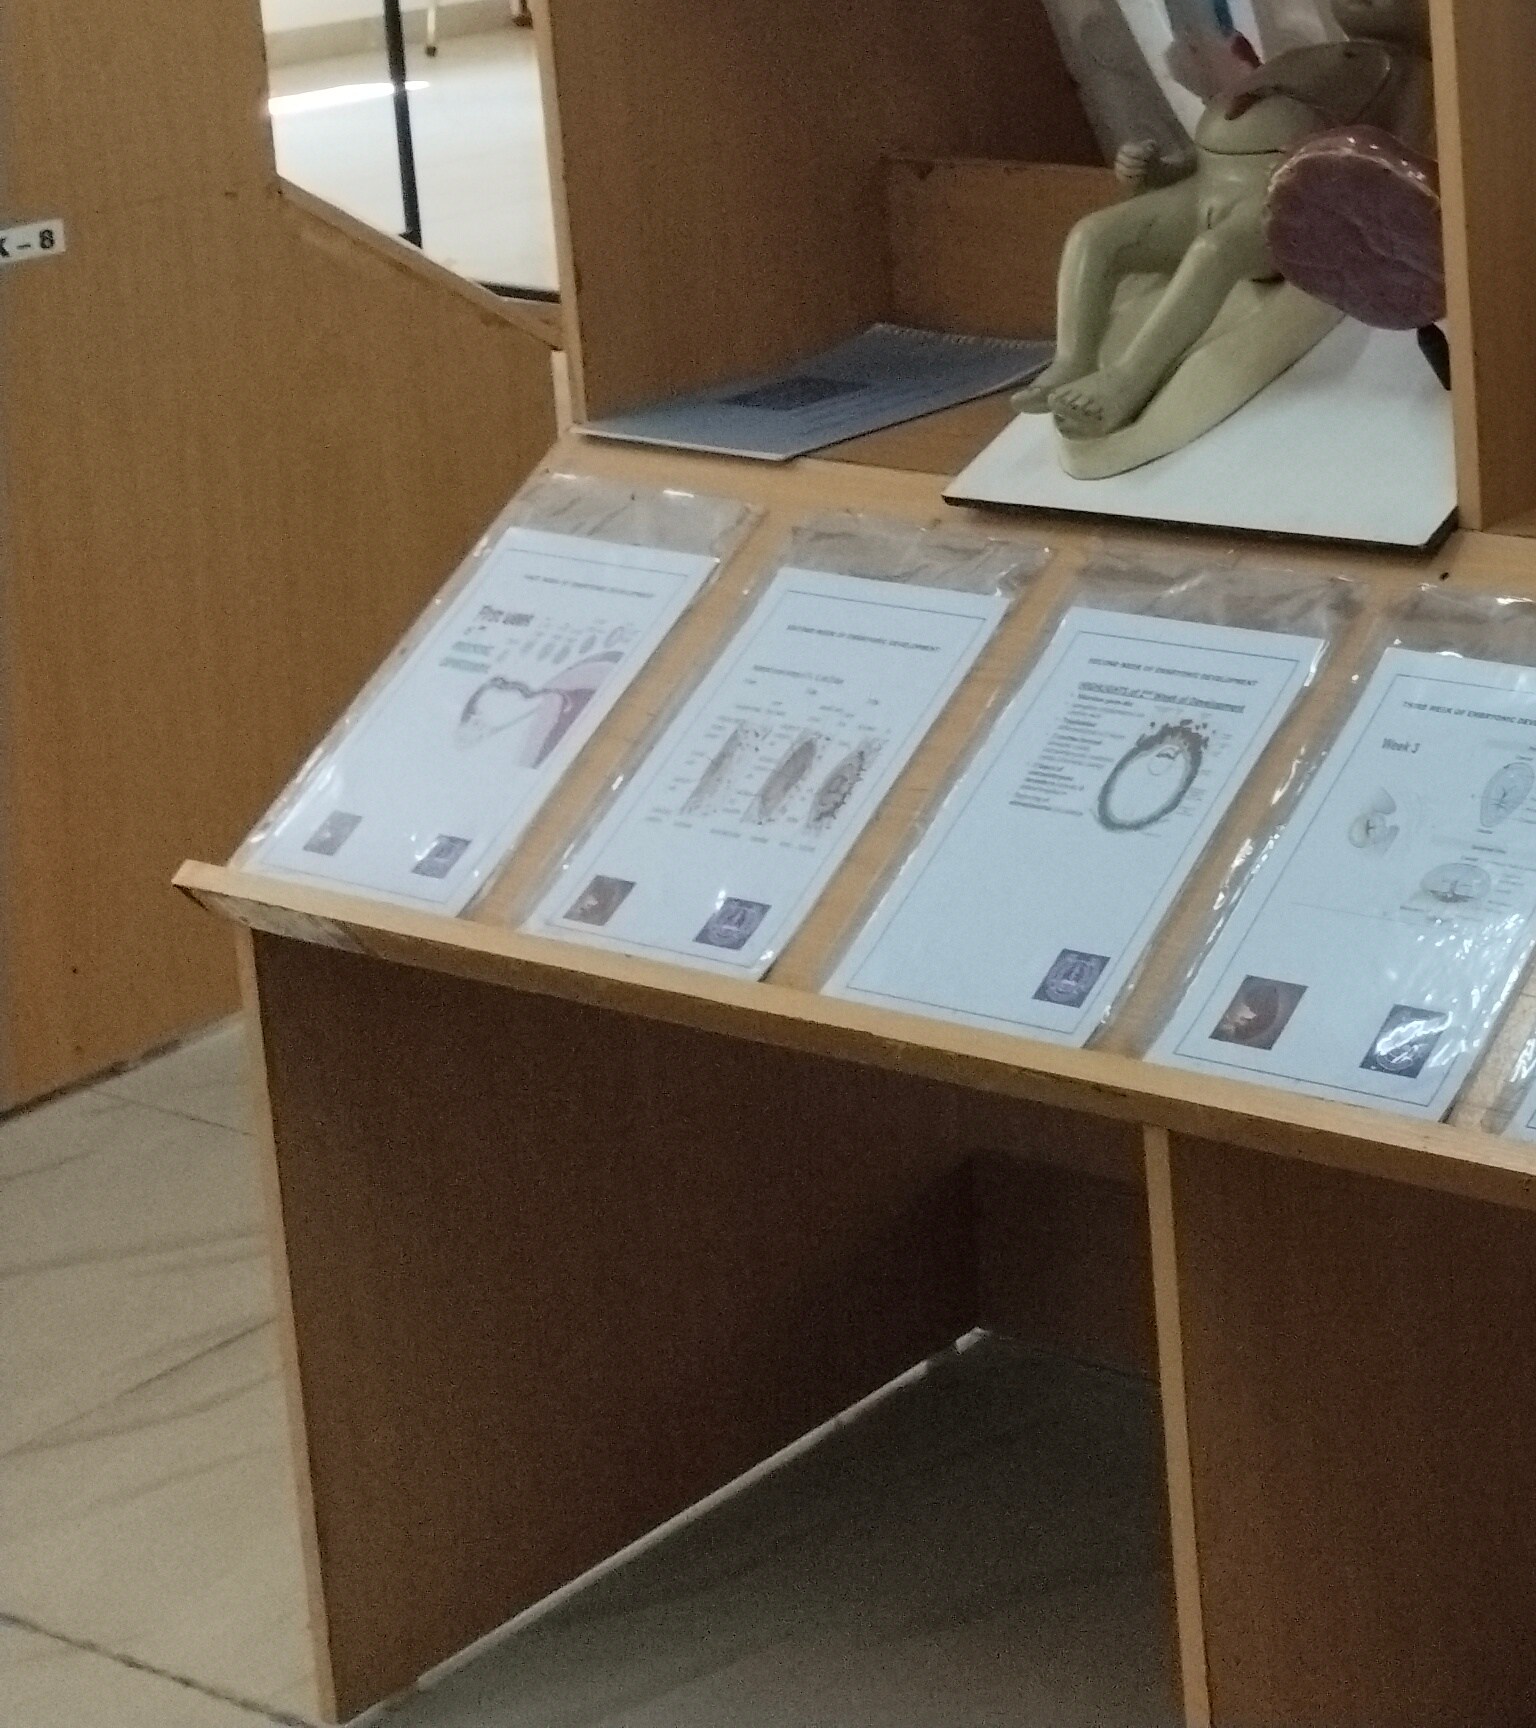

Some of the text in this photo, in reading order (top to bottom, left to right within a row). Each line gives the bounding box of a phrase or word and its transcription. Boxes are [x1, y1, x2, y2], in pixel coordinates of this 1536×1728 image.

[1429, 704, 1452, 715] WEEK
[1454, 708, 1466, 716] OF
[1467, 710, 1517, 724] EMBRYONIC
[1382, 737, 1410, 752] Week
